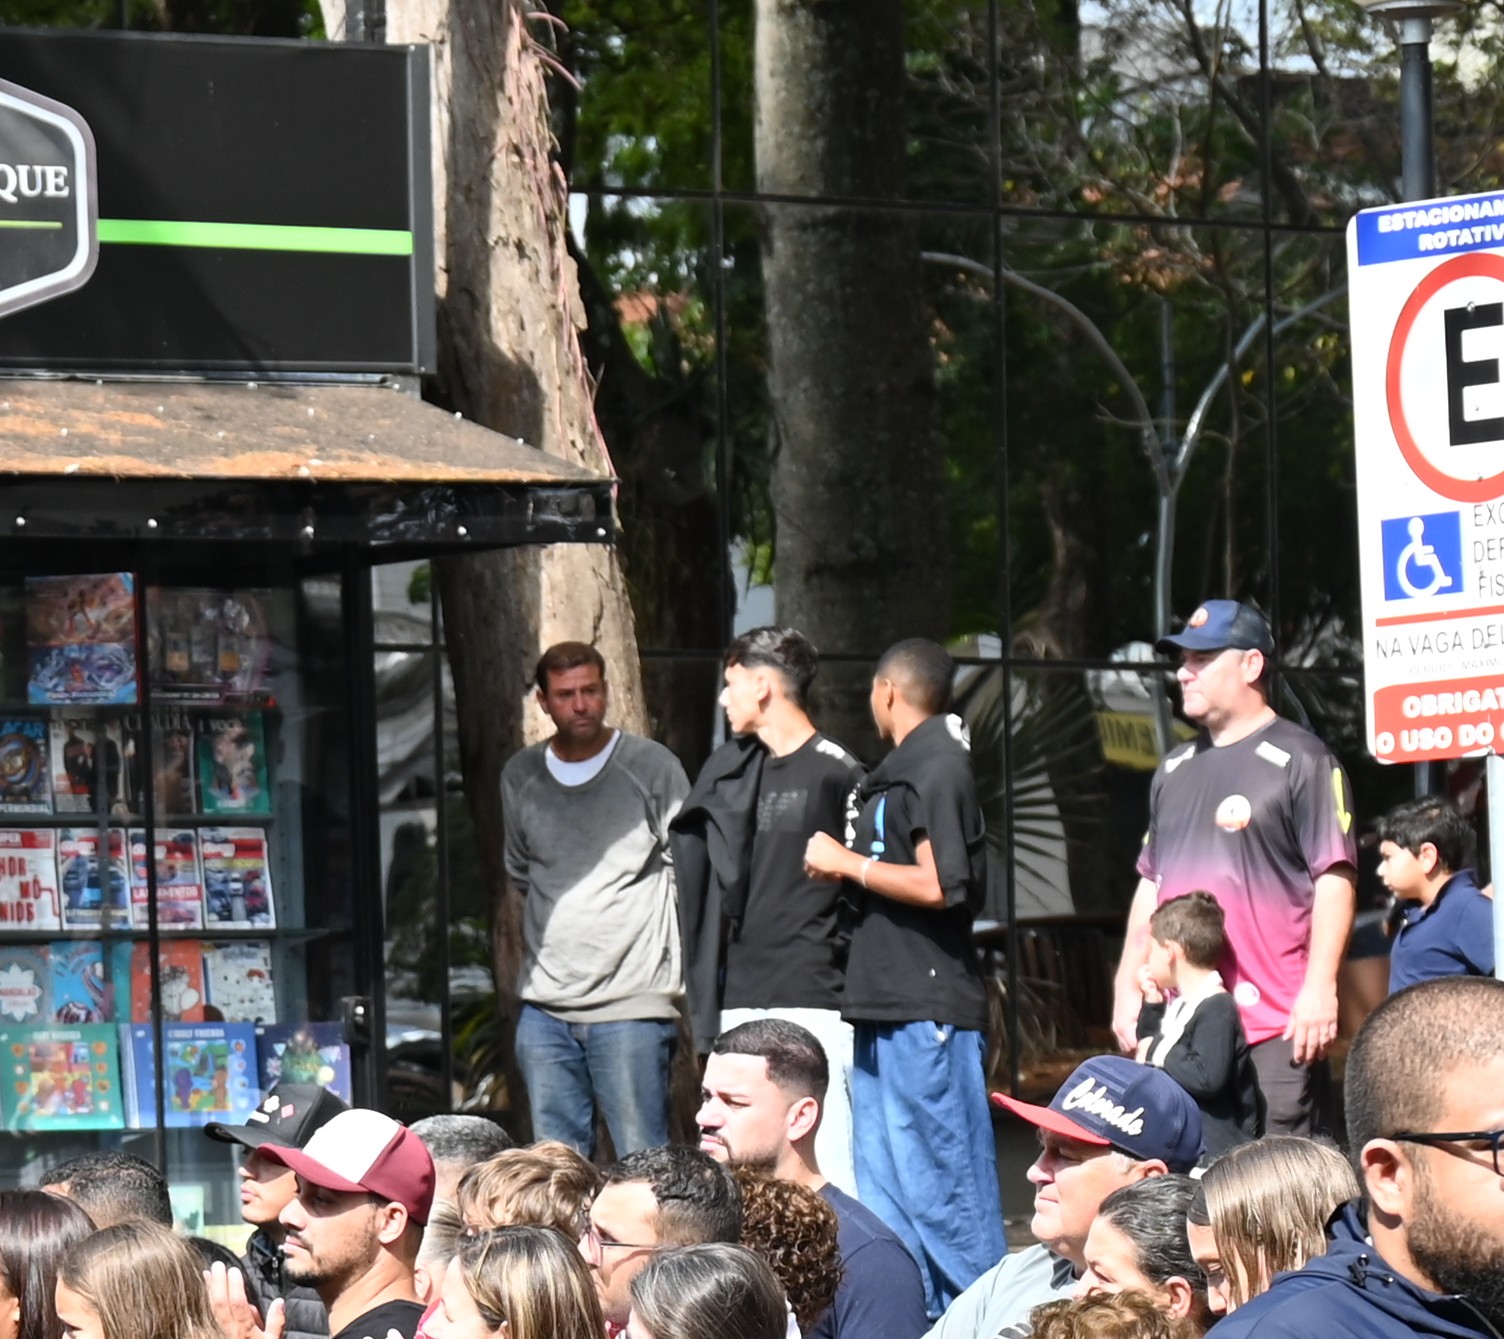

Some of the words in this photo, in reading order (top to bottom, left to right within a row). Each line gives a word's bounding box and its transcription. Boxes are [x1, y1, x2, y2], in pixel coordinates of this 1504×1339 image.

[1376, 637, 1403, 660] NA
[1408, 631, 1464, 656] VAGA
[1376, 731, 1396, 755] O
[1400, 727, 1453, 752] USO
[1458, 722, 1495, 746] DO
[1062, 1077, 1145, 1136] Colorado
